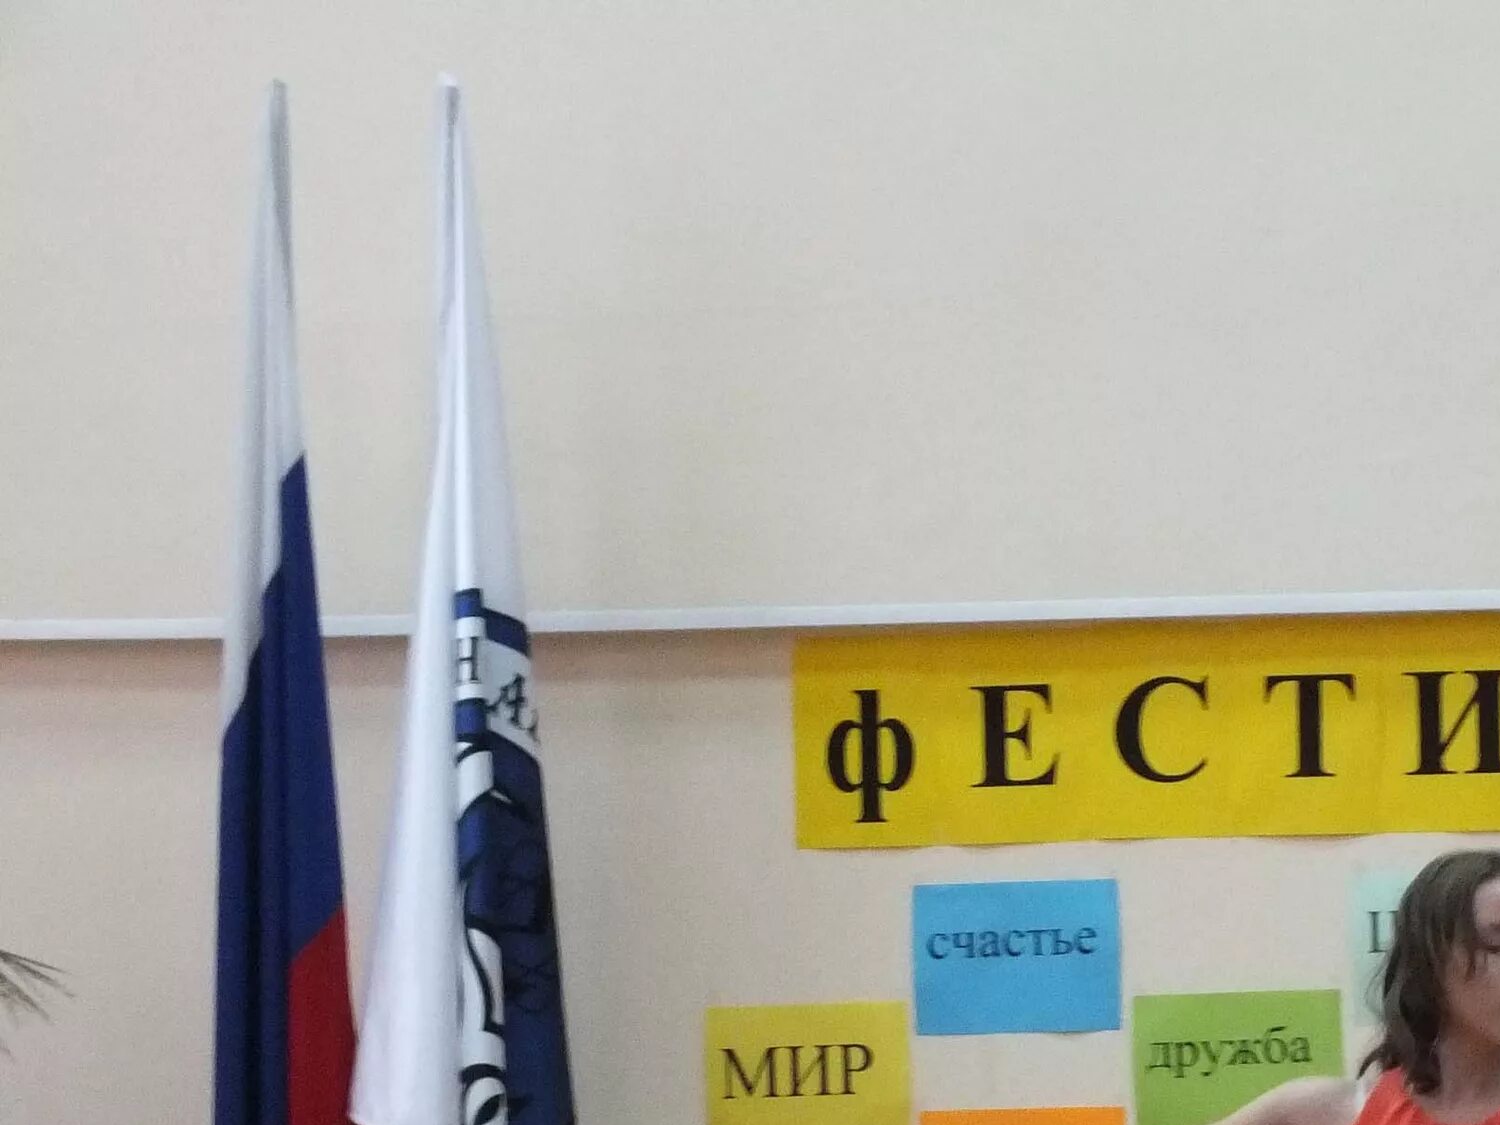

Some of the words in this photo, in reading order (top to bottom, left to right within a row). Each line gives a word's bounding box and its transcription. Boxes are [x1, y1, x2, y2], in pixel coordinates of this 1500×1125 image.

[926, 926, 1099, 961] счастье
[721, 1043, 874, 1100] МИР
[1145, 1026, 1313, 1079] дружба
